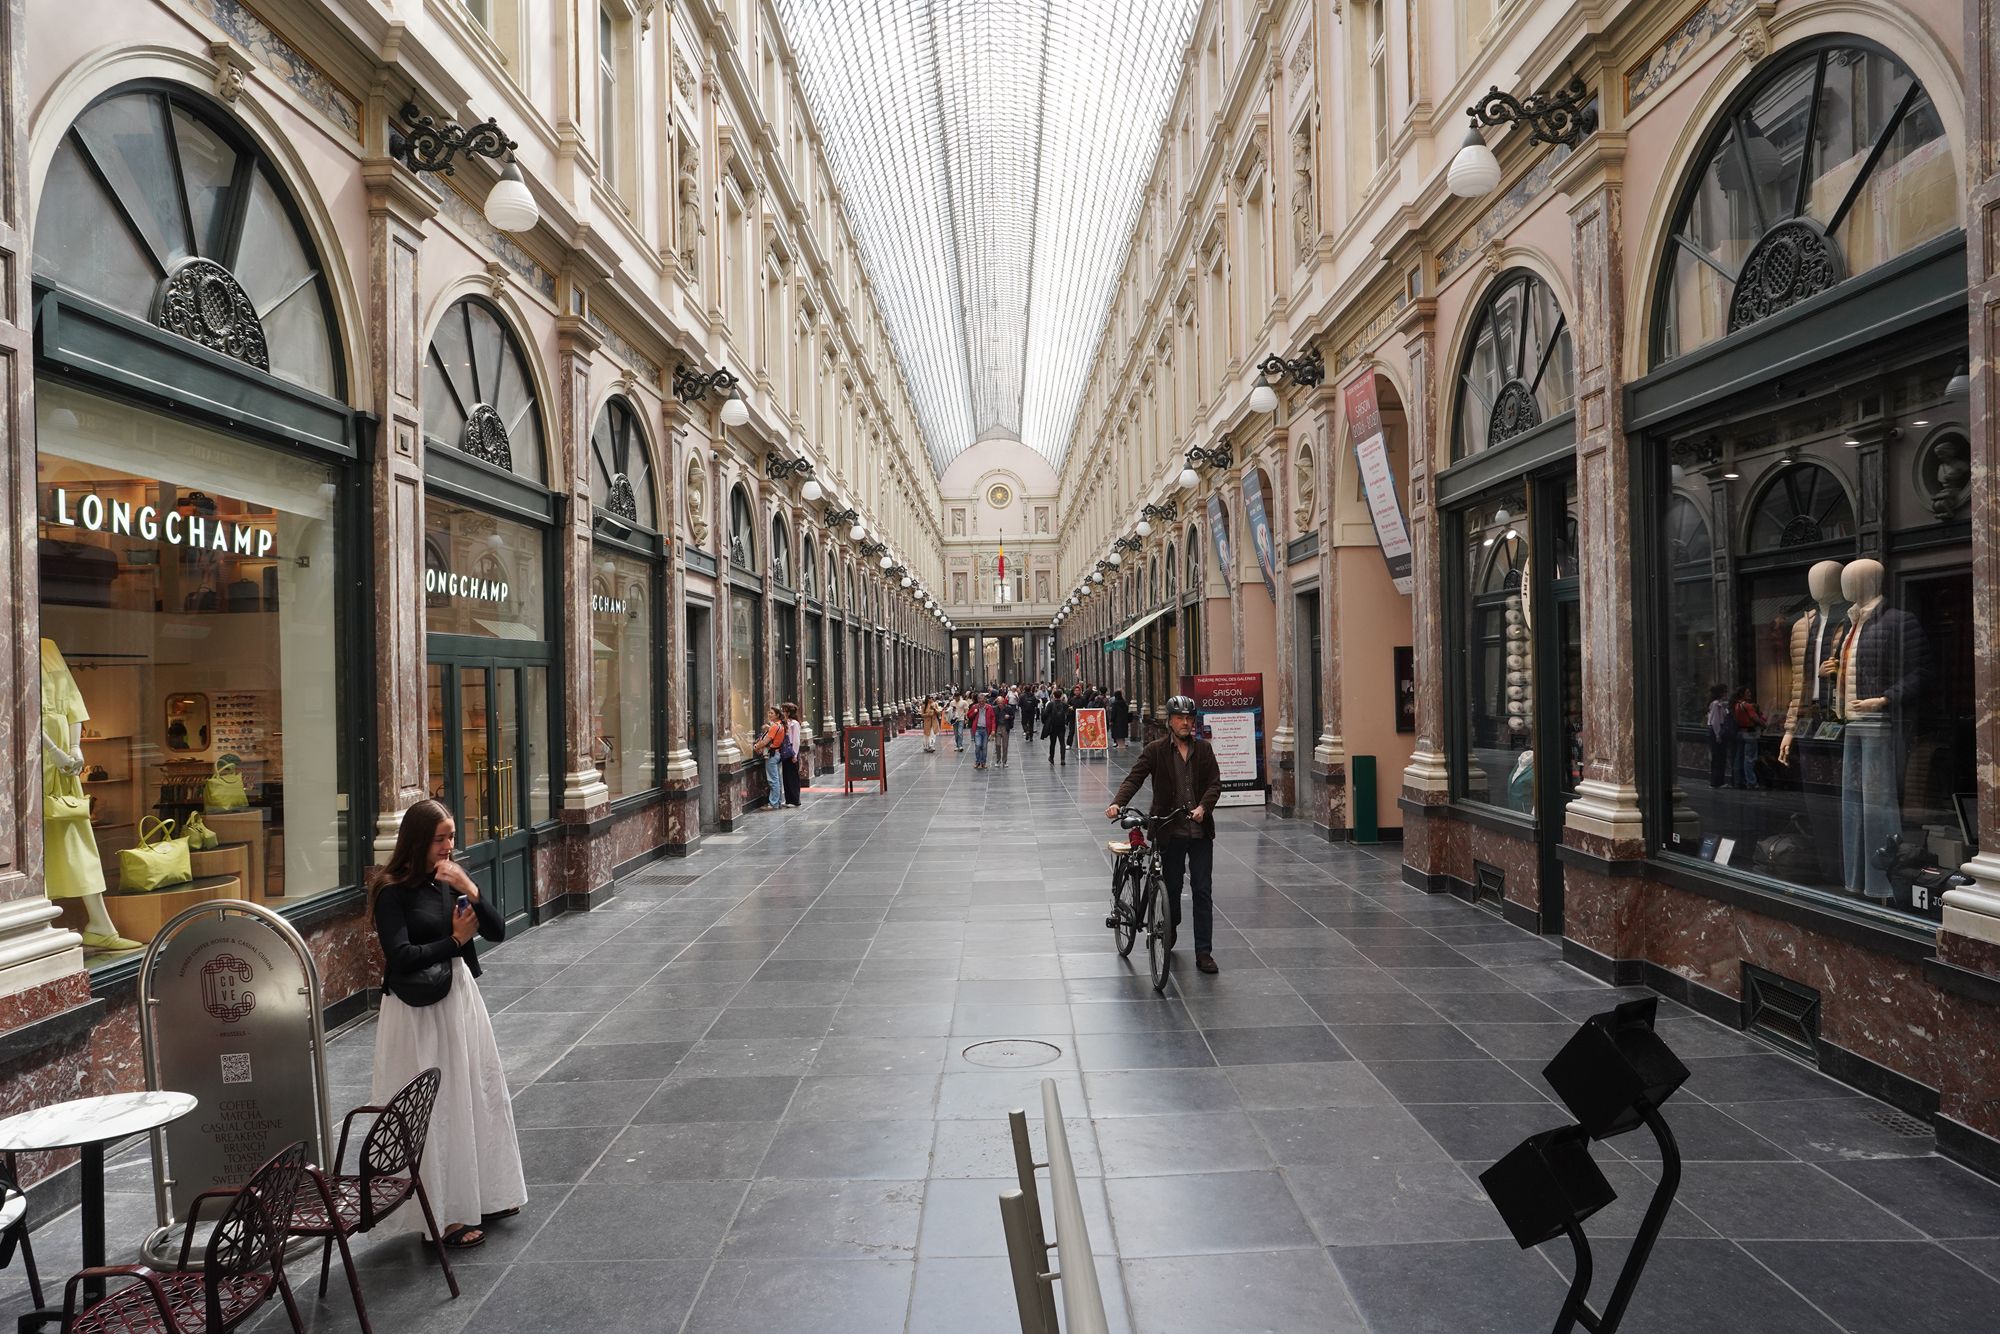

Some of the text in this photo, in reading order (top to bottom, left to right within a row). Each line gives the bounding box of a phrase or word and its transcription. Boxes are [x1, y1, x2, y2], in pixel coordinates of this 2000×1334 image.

[57, 488, 273, 558] LONGCHAMP
[425, 568, 509, 602] ONGCHAMP
[592, 594, 627, 615] GCHAMP
[1212, 688, 1242, 697] SAISON
[1202, 698, 1225, 707] 2026
[1231, 697, 1254, 706] 2027
[850, 737, 865, 749] SAY
[862, 762, 878, 772] ART
[211, 937, 229, 946] HOUSE
[237, 939, 258, 953] CASUAL
[258, 951, 274, 971] CUISINE
[219, 1100, 257, 1111] COFFEE
[220, 1110, 262, 1120] MATCHA
[201, 1119, 283, 1134] CASUAL CUISINE
[215, 1131, 268, 1143] BREAKFAST
[224, 1141, 265, 1153] BRUNCH
[227, 1152, 263, 1163] TOASTS
[212, 1174, 244, 1185] SWEET
